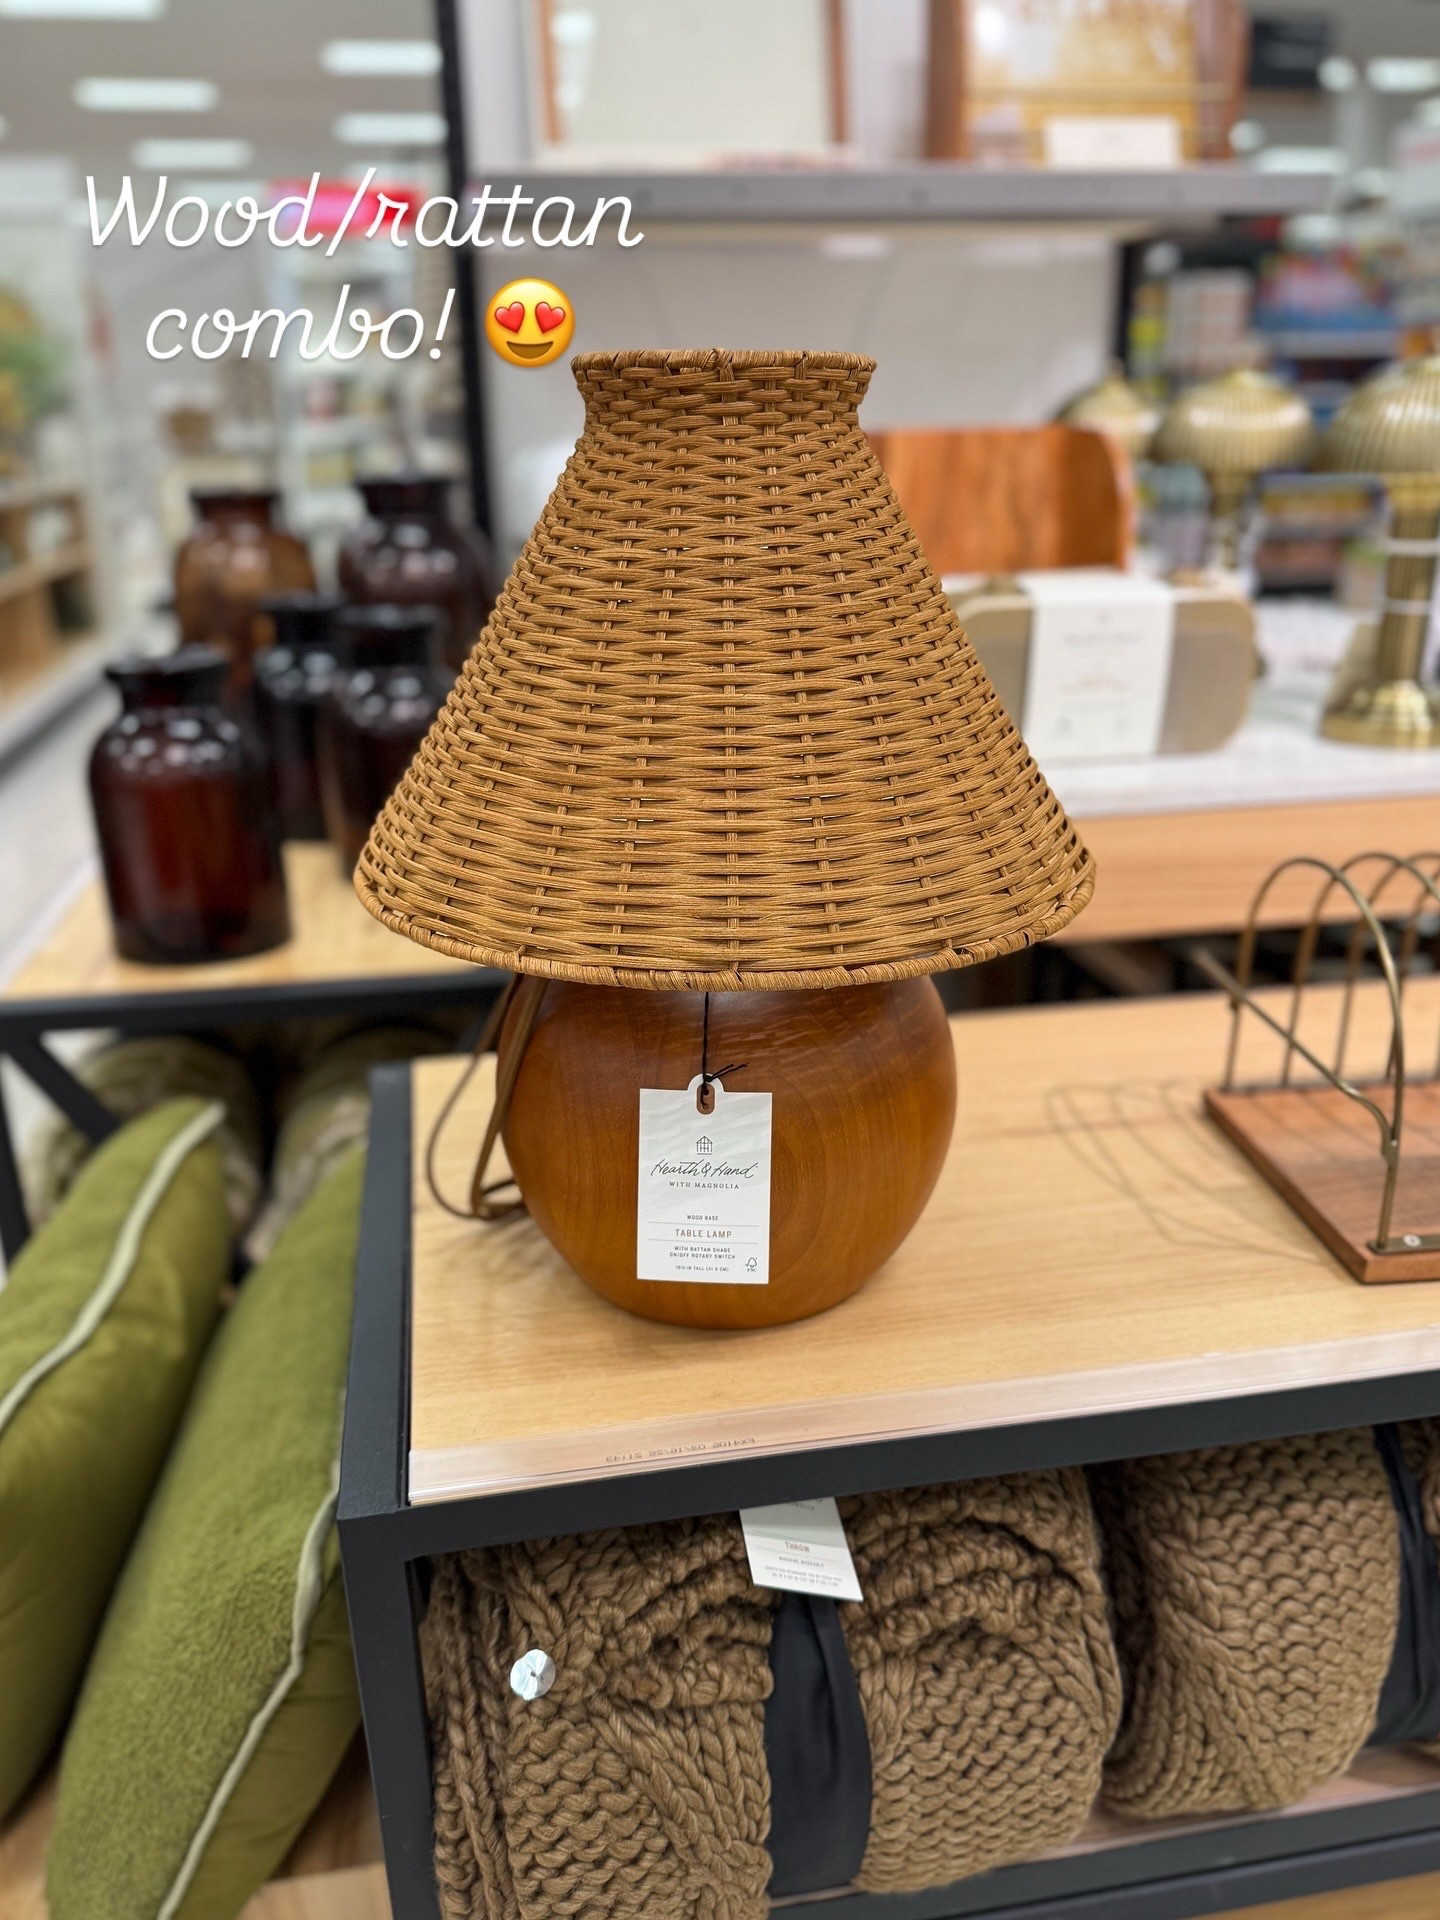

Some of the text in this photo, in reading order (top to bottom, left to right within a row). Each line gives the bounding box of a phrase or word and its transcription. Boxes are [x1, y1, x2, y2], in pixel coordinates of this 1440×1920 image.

[651, 1159, 758, 1179] Hearth & Hand
[675, 1229, 732, 1238] TABLE LAMP
[785, 1541, 810, 1552] THROW
